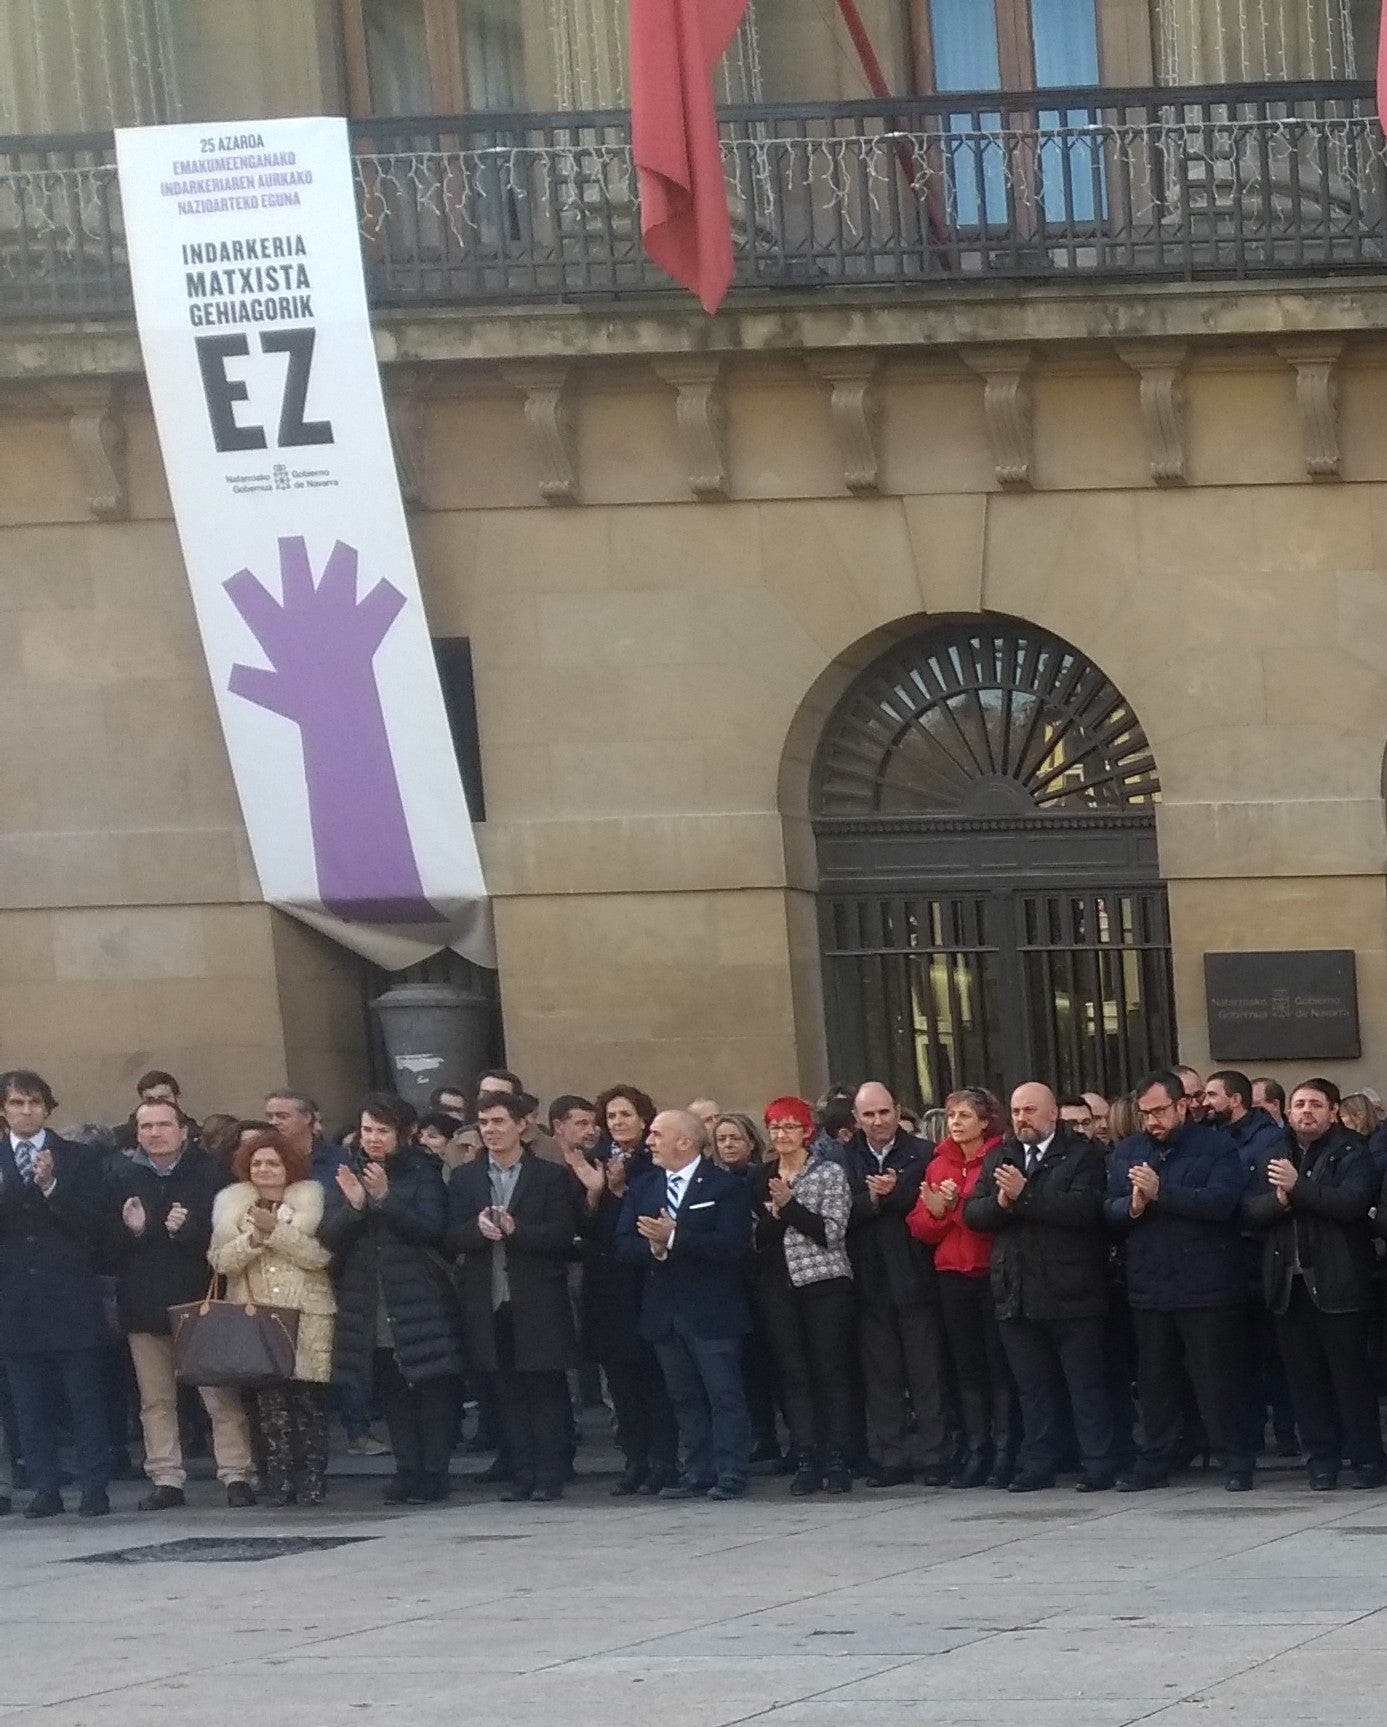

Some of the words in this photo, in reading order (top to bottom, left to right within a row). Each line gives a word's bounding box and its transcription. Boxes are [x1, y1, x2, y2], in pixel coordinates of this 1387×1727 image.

[200, 137, 216, 153] 25
[218, 134, 265, 152] AZAROA
[172, 151, 297, 175] EMAKUMEENGANAKO
[160, 174, 256, 197] INDARKERIAREN
[257, 171, 313, 190] AURKAKO
[178, 195, 259, 216] NAZIOARTEKO
[260, 191, 302, 209] EGUNA
[181, 234, 307, 265] INDARKERIA
[185, 263, 312, 299] MATXISTA
[189, 294, 315, 327] GEHIAGORIK
[194, 326, 335, 453] EZ
[225, 473, 271, 484] Nafarroako
[291, 469, 330, 479] Gobierno
[294, 480, 304, 489] de
[306, 478, 339, 489] Navarra
[232, 484, 274, 494] Gobernua
